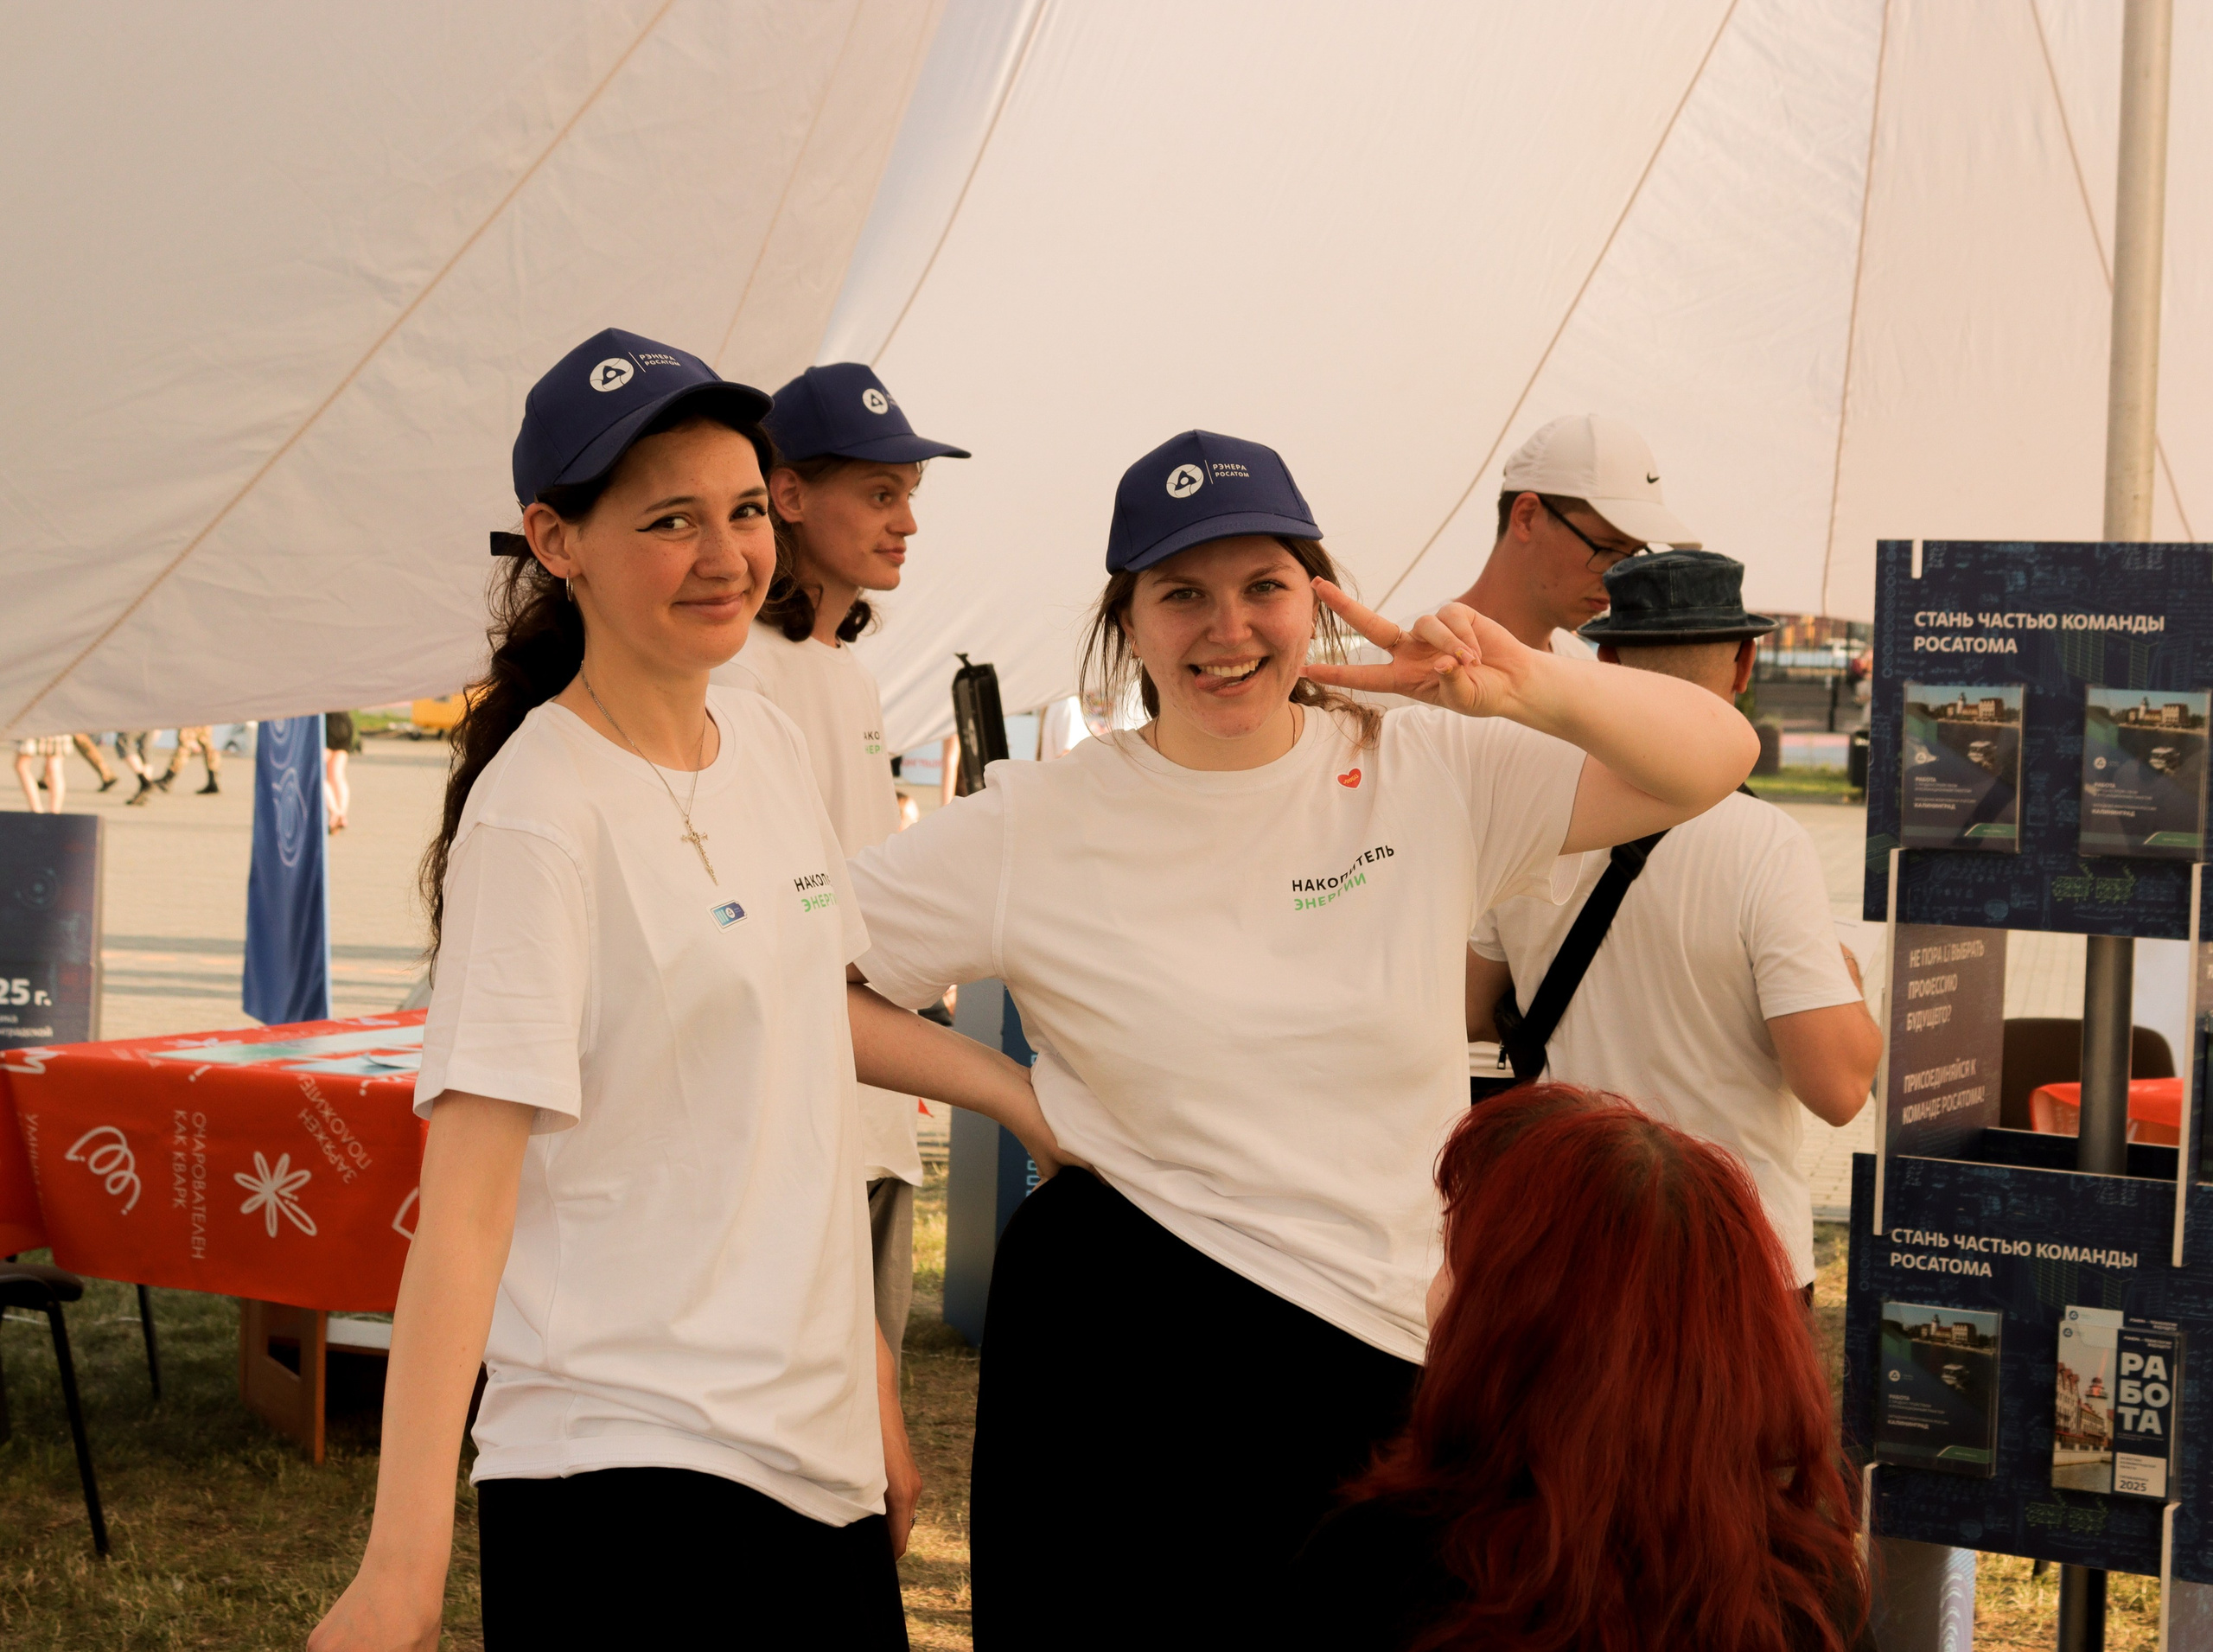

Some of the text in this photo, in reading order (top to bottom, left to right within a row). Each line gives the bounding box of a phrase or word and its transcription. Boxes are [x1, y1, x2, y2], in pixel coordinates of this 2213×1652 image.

[1914, 611, 2165, 635] СТАНЬ ЧАСТЬЮ КОМАНДЫ
[1913, 635, 2019, 654] РОСАТОМА
[1910, 949, 1921, 968] НЕ
[1922, 946, 1942, 966] ПОРА
[1951, 939, 1985, 961] ВЫБРАТЬ
[1907, 973, 1958, 999] ПРОФЕССИЮ
[1906, 1005, 1953, 1033] БУДУЩЕГО?
[1904, 1057, 1977, 1094] ПРИСОЕДИНЯЙСЯ К
[1903, 1085, 1986, 1125] КОМАНДЕ РОСАТОМА!
[173, 1110, 188, 1210] КАК КВАРК
[297, 1107, 358, 1184] ЗАРЯЖЕН
[191, 1111, 207, 1260] ОЧАРОВАТЕЛЕН
[1891, 1228, 2139, 1269] СТАНЬ ЧАСТЬЮ КОМАНДЫ
[1890, 1252, 1993, 1278] РОСАТОМА
[2120, 1479, 2146, 1492] 2025
